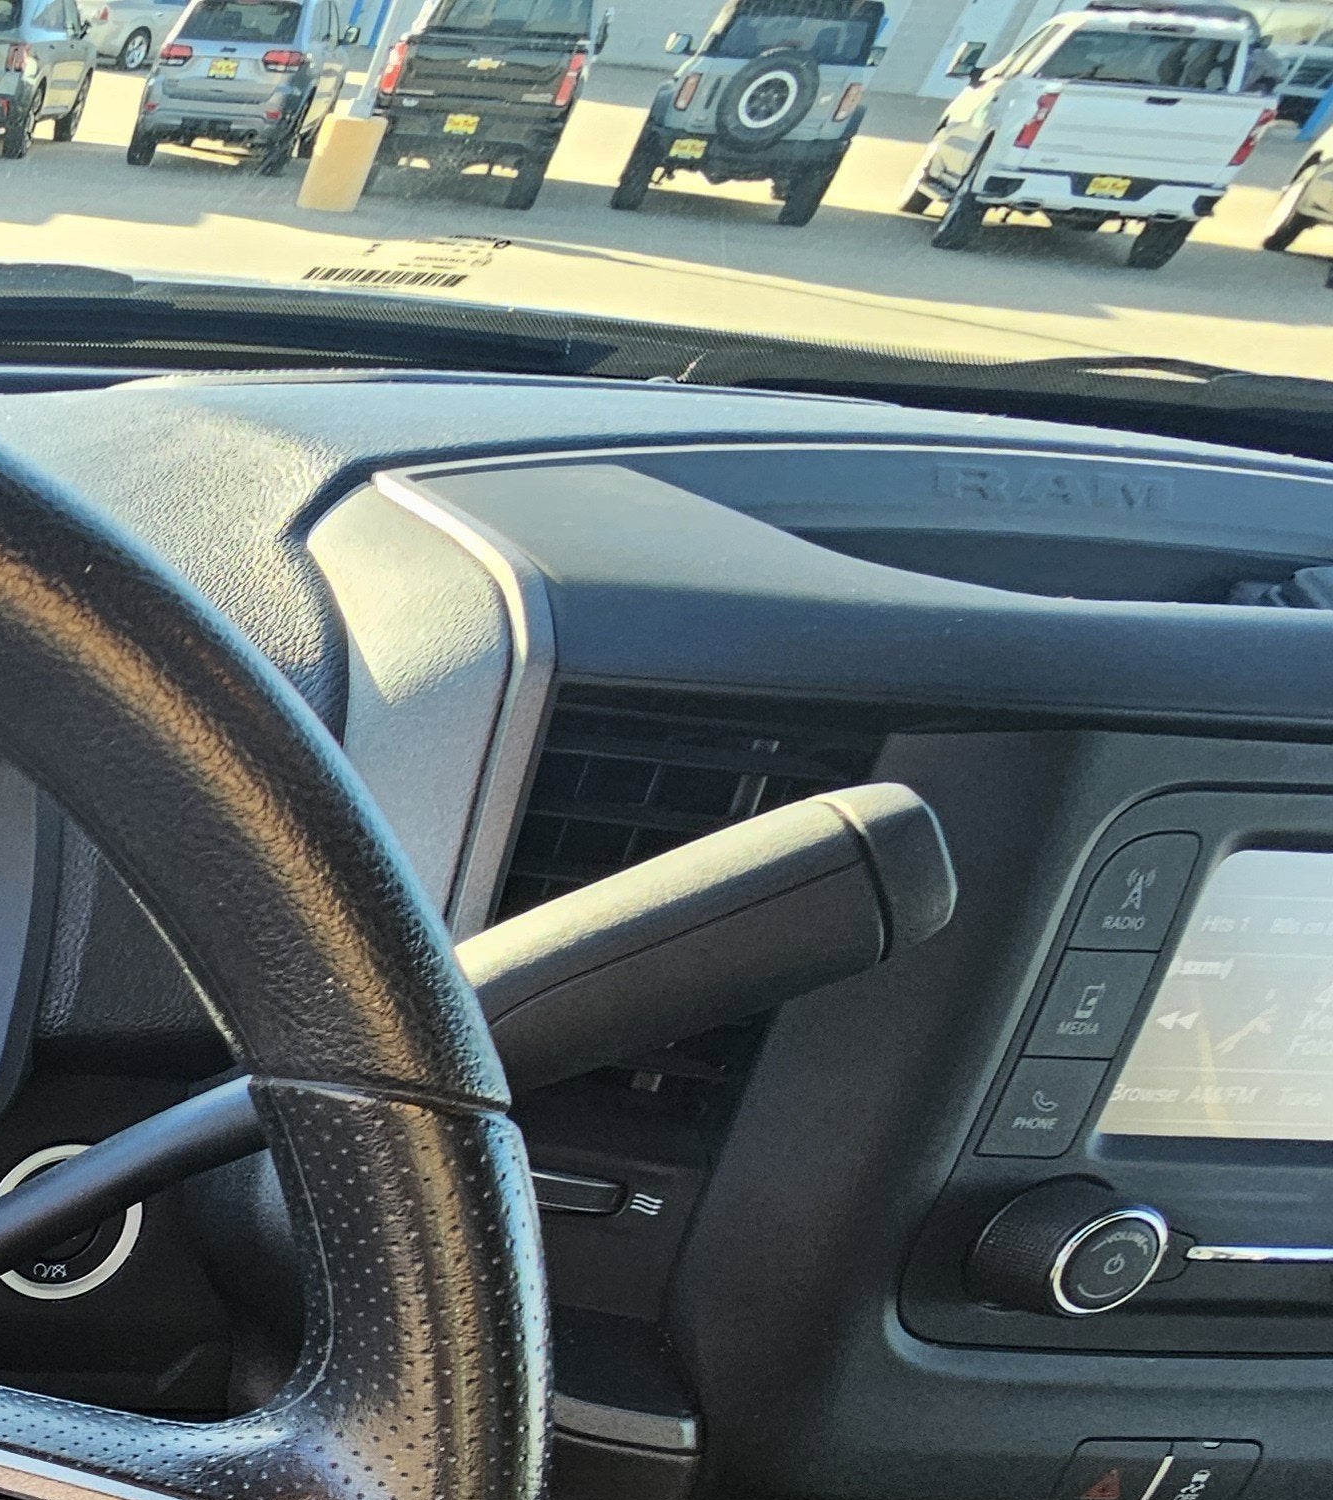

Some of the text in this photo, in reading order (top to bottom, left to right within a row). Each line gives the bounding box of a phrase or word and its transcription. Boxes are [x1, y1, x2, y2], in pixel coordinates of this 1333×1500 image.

[933, 463, 1176, 508] RAM
[1102, 916, 1146, 931] RADIO
[1057, 1021, 1099, 1035] MEDIA
[1107, 1083, 1180, 1103] Browse
[1011, 1116, 1058, 1130] PHONE
